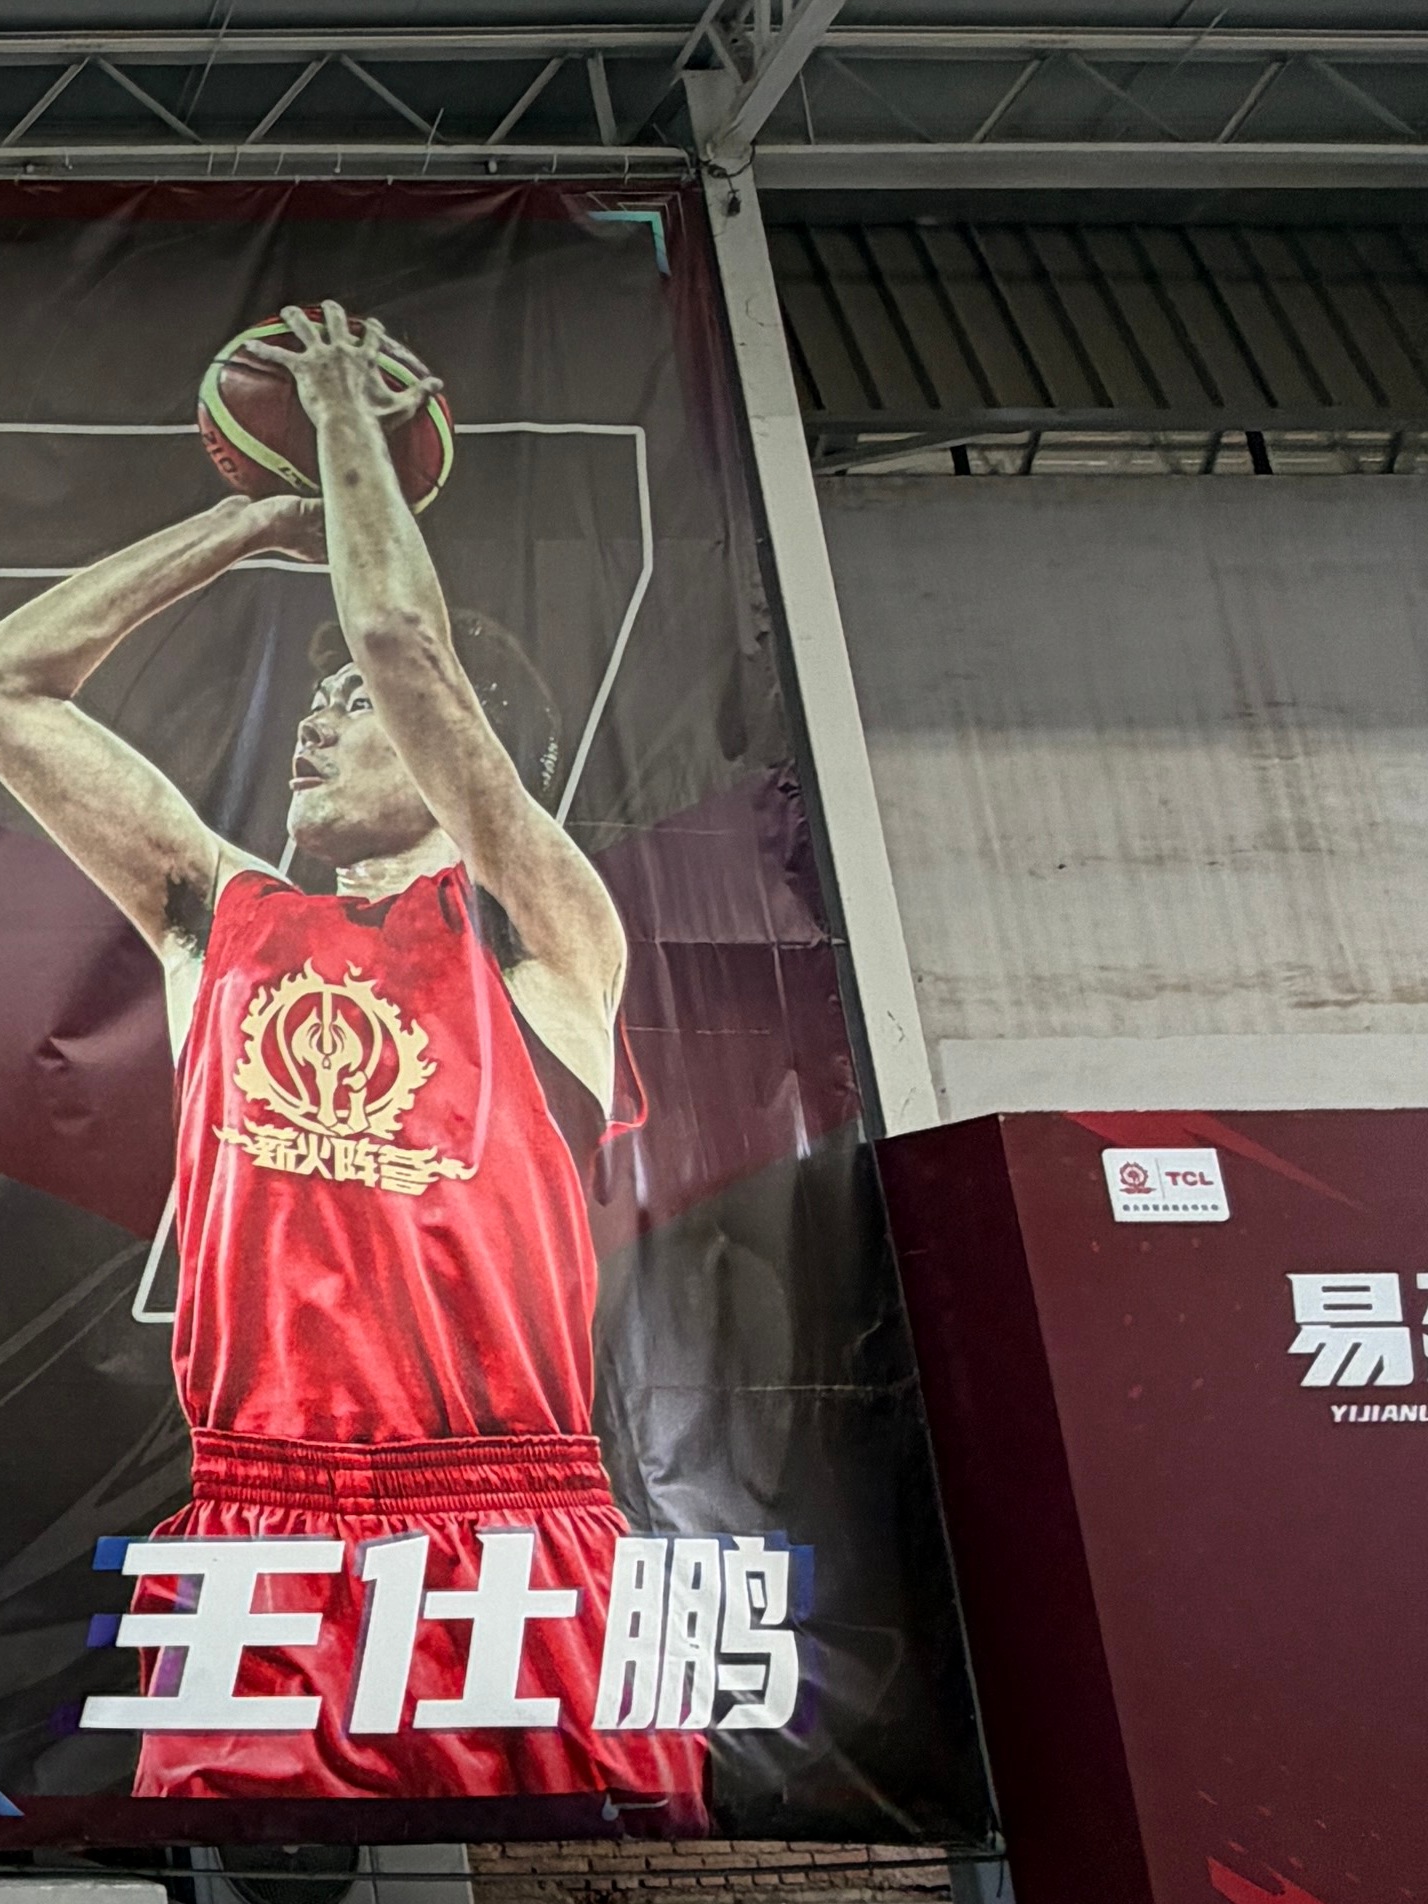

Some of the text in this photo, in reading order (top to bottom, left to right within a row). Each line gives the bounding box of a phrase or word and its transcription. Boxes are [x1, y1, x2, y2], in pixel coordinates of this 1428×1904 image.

[244, 1123, 439, 1196] 薪火阵营
[1164, 1171, 1215, 1187] TCL
[1285, 1272, 1428, 1387] 易
[78, 1531, 798, 1734] 王仕鹏
